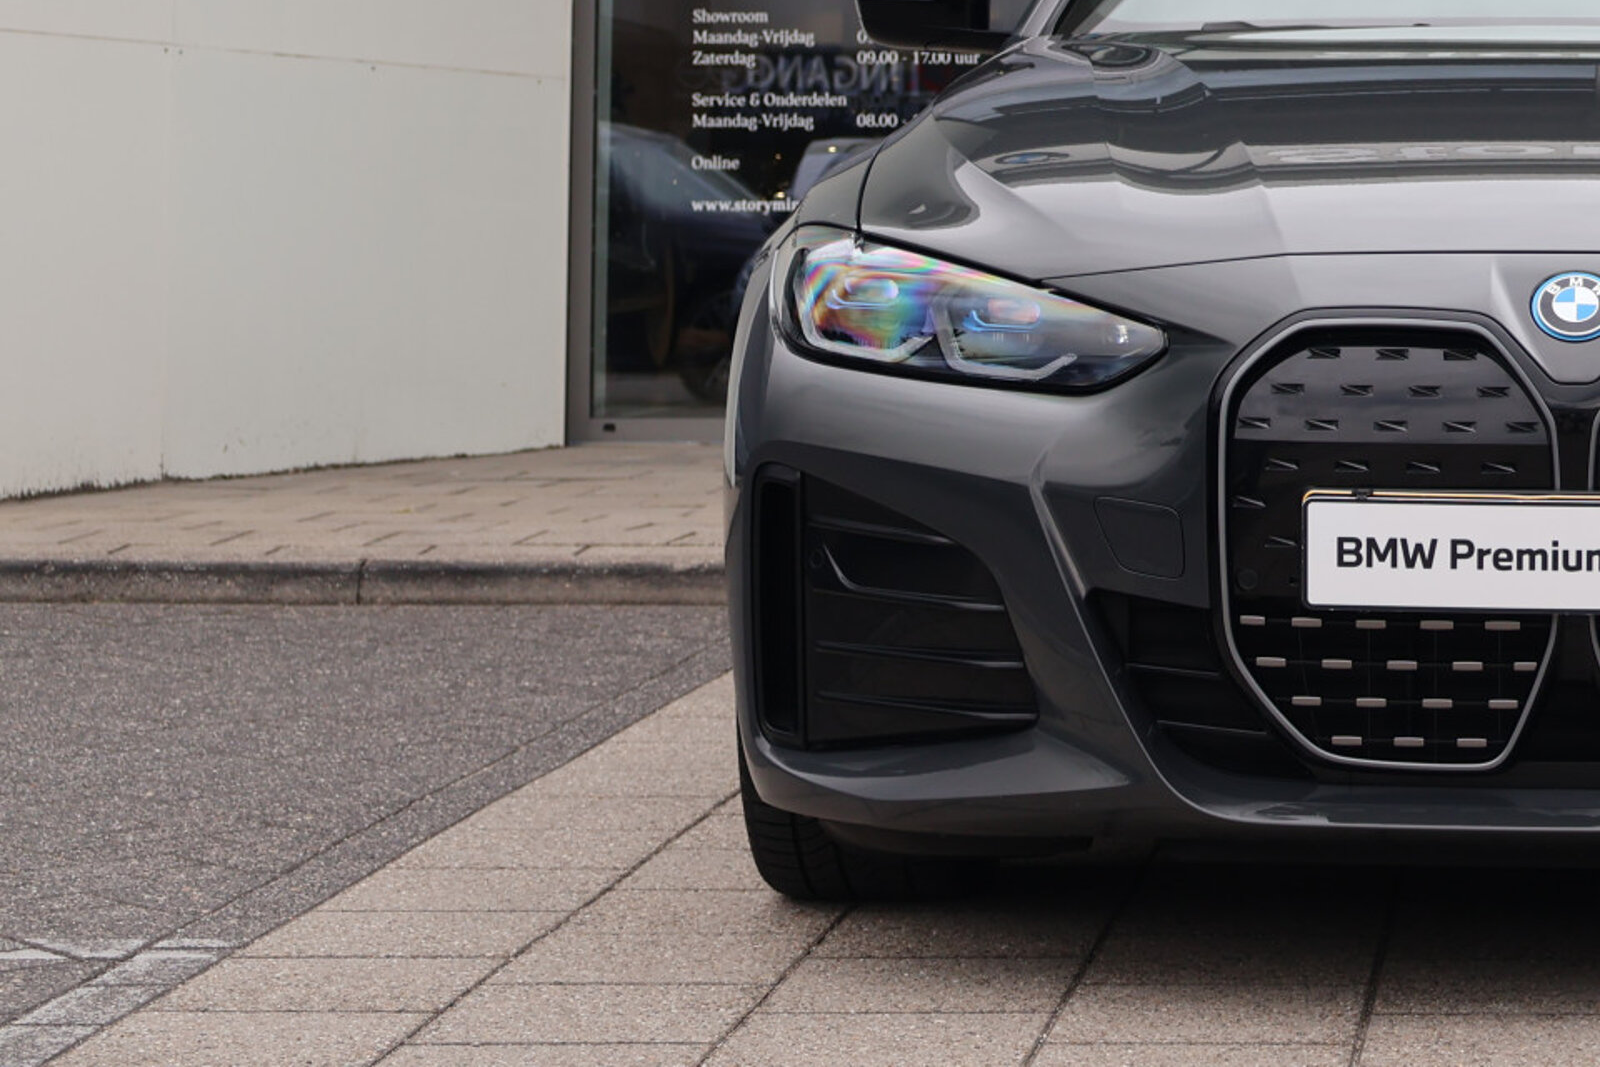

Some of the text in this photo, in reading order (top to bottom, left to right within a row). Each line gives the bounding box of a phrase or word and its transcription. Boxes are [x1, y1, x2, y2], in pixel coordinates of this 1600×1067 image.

[692, 9, 768, 24] Showroom
[692, 29, 815, 47] Maandag-Vrijdag
[692, 50, 755, 67] Zaterdag
[856, 50, 899, 65] 09.00
[913, 51, 951, 65] 17.00
[954, 53, 980, 65] uur
[692, 92, 848, 107] Service & Onderdelen
[692, 113, 815, 130] Maandag-Vrijdag
[856, 113, 899, 128] 08.00
[691, 156, 740, 170] Online
[1335, 536, 1438, 570] BMW
